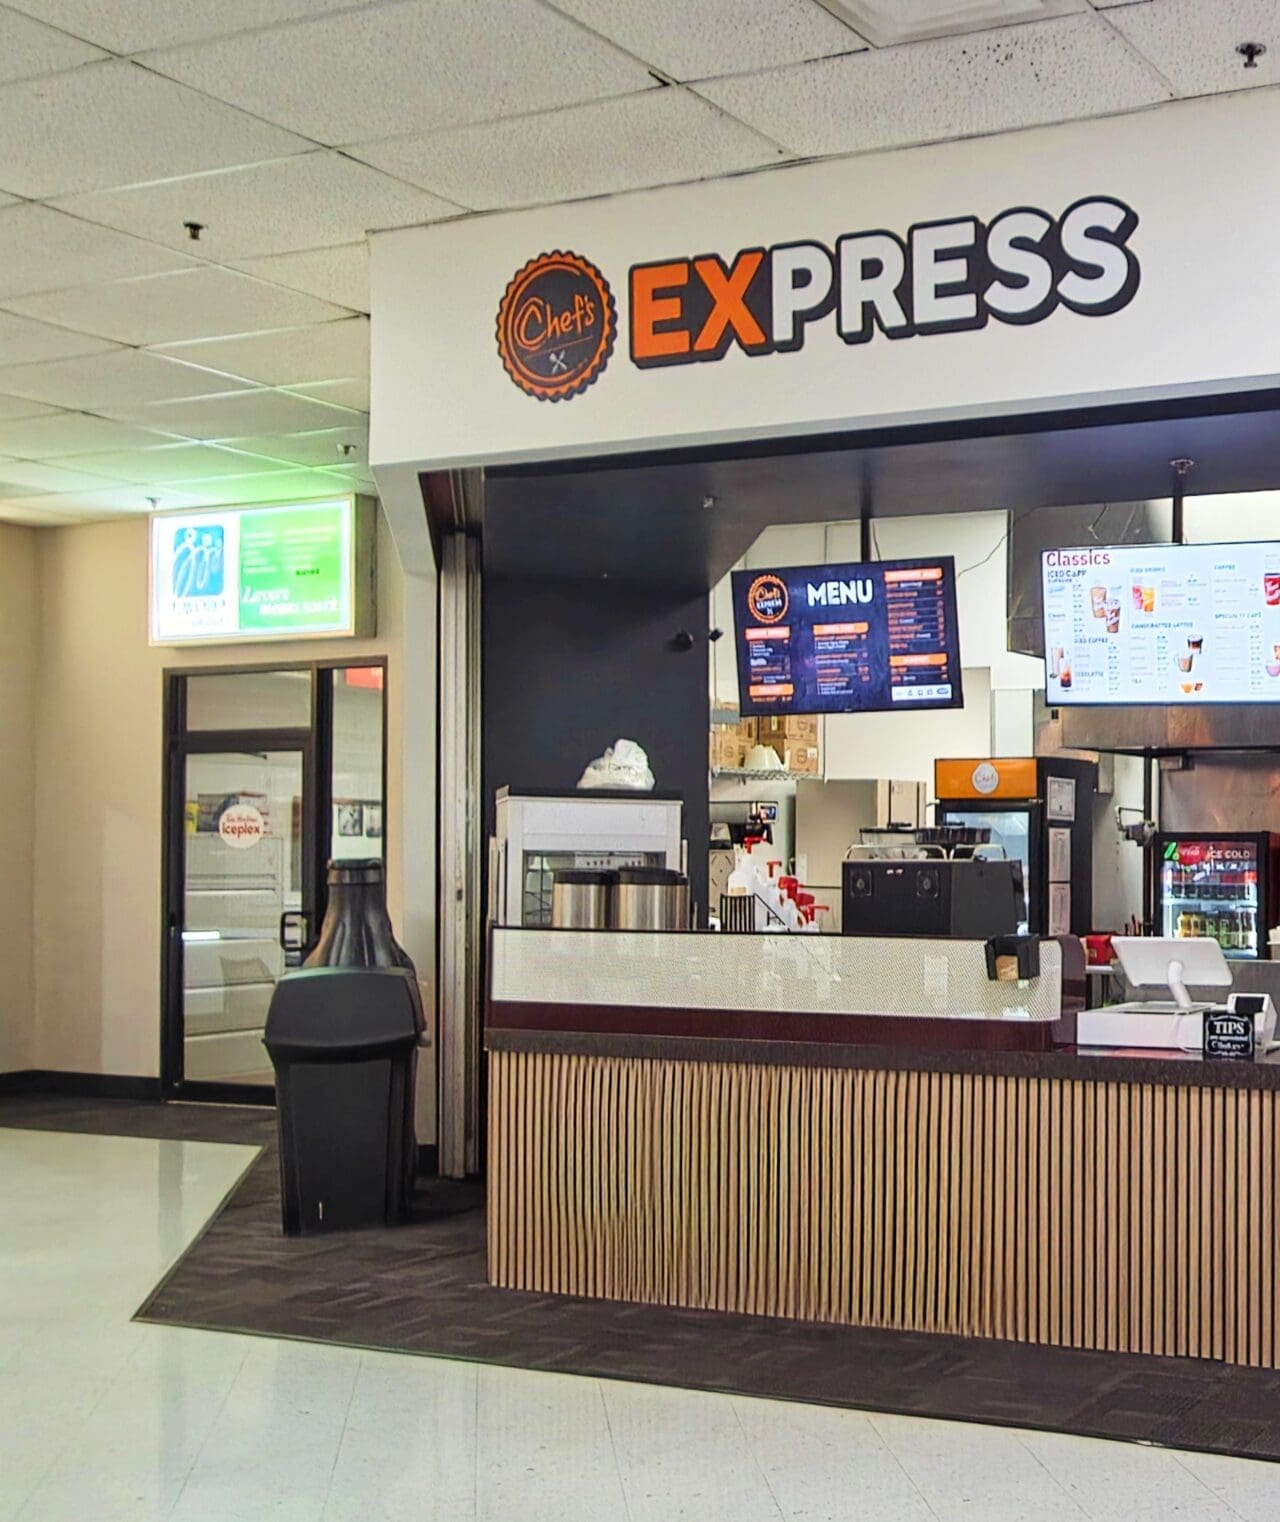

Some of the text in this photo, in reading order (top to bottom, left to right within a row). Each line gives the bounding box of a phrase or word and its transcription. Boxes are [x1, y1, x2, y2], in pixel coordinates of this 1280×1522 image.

[629, 195, 1140, 370] EXPRESS
[513, 294, 596, 352] Chef's
[1046, 551, 1111, 567] Classics
[807, 579, 873, 607] MENU
[222, 823, 260, 838] Iceplex
[1224, 849, 1250, 859] COLD
[1213, 1021, 1245, 1035] TIPS
